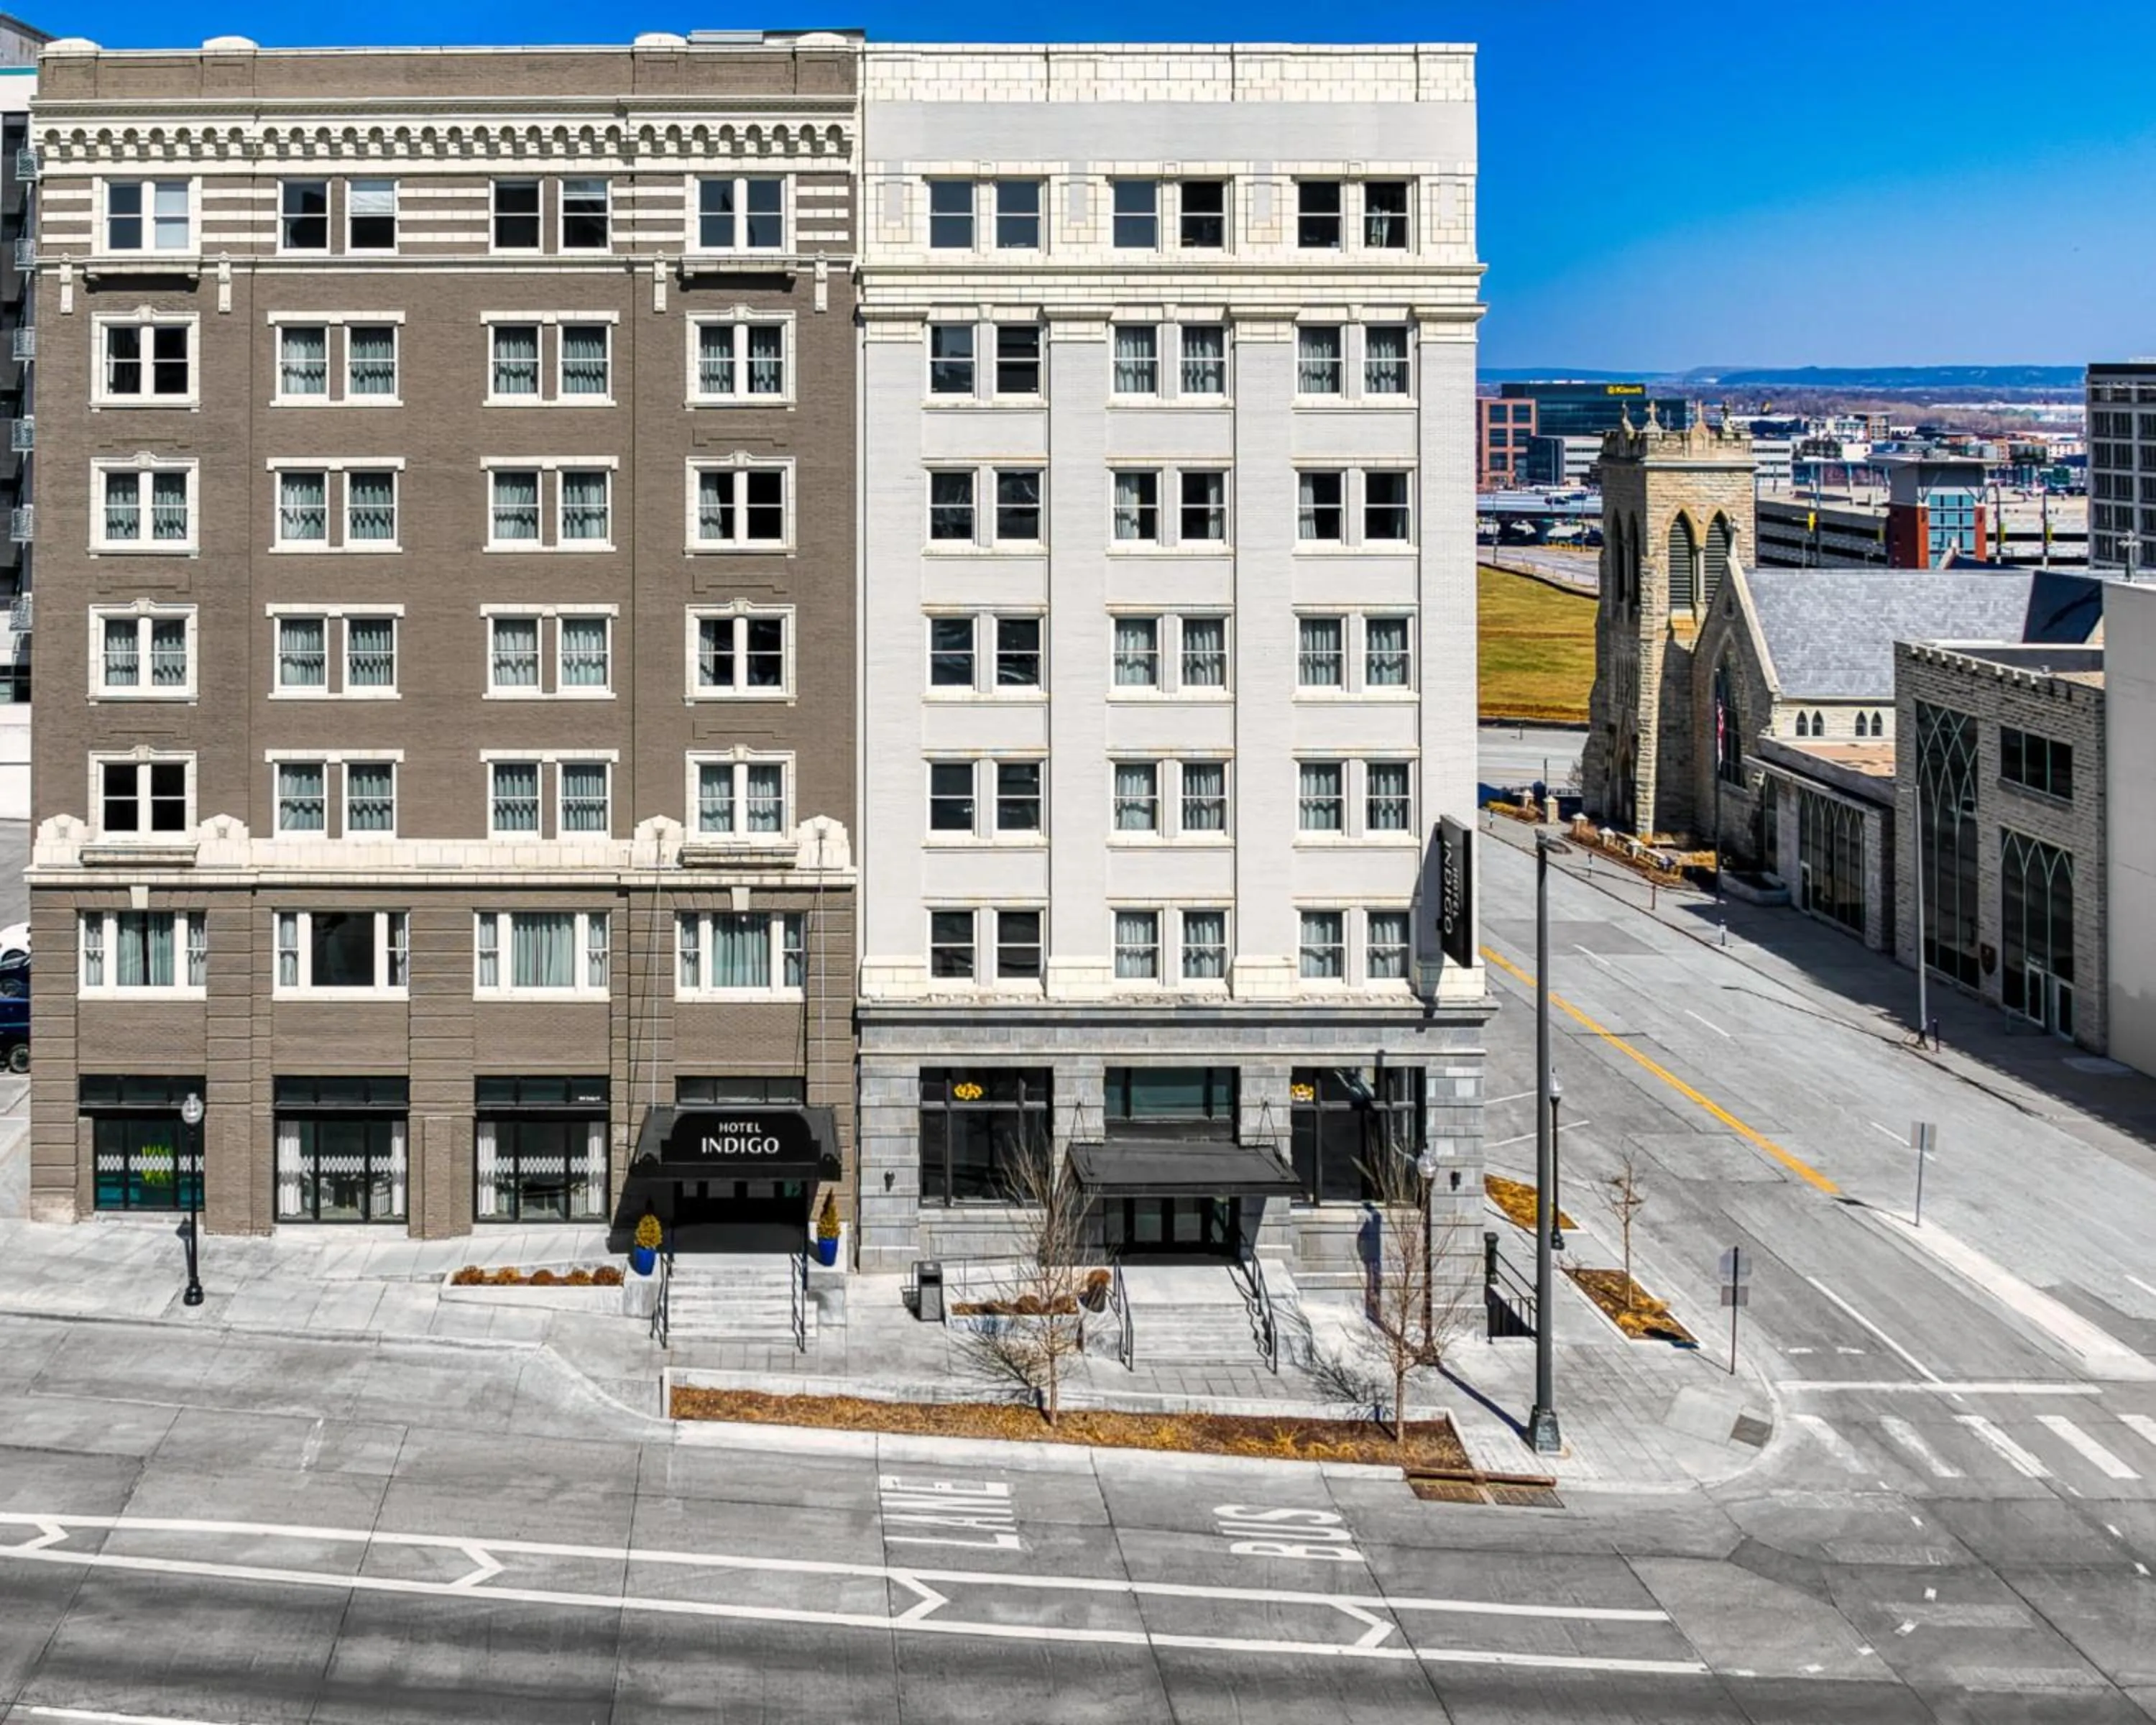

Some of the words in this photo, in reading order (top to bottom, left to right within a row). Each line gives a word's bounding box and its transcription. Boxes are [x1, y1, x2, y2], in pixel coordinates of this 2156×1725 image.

[1444, 840, 1453, 934] INDIGO
[701, 1137, 780, 1154] INDIGO
[719, 1122, 762, 1133] HOTEL
[880, 1475, 1021, 1550] LANE
[1213, 1505, 1365, 1562] BUS
